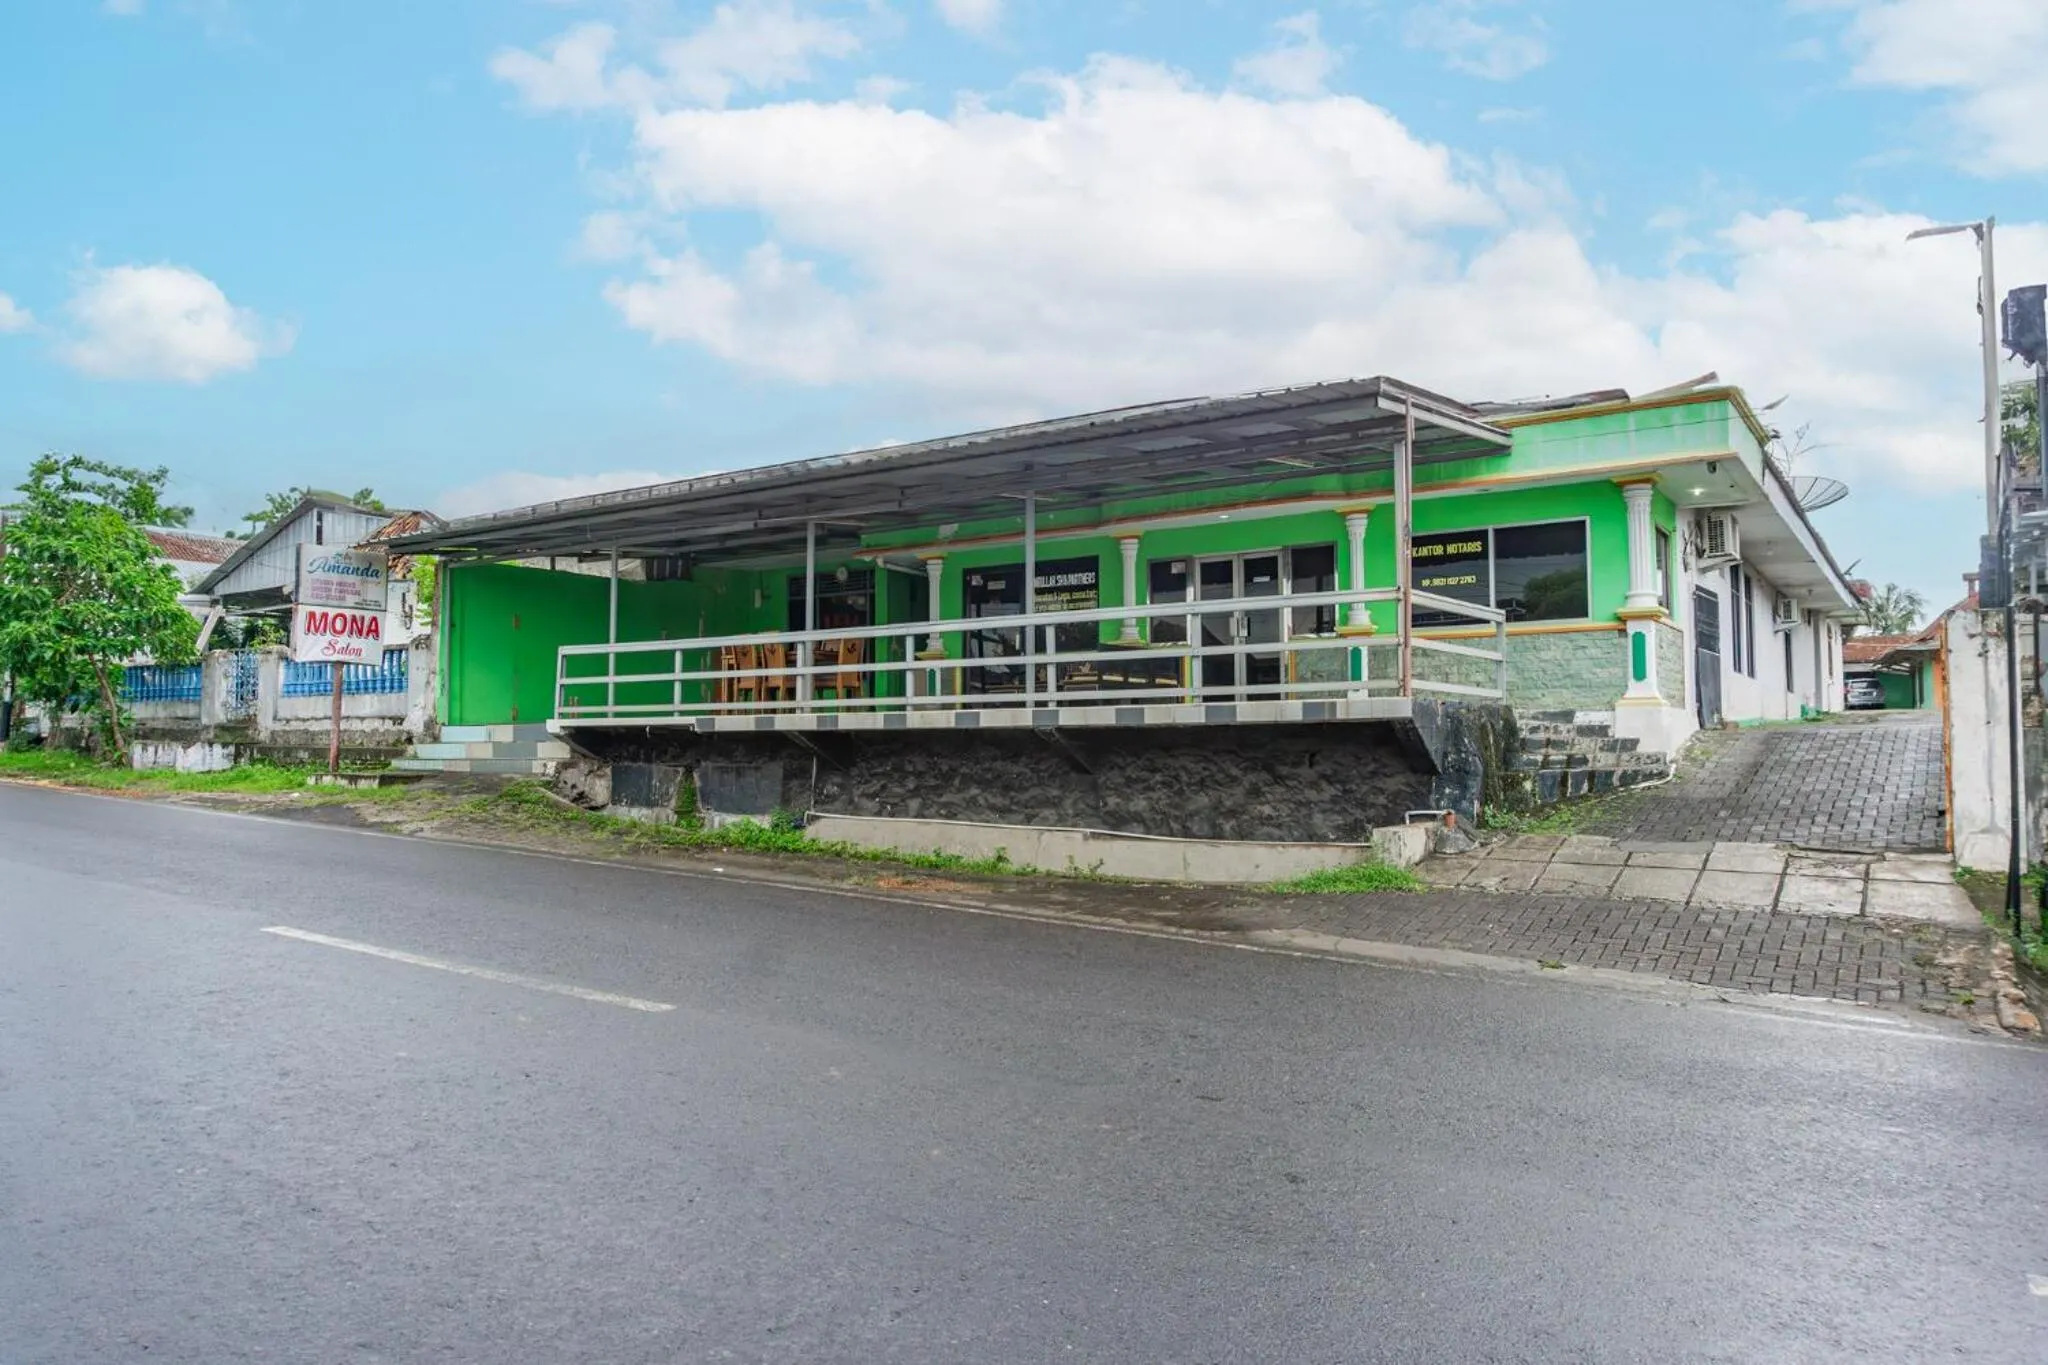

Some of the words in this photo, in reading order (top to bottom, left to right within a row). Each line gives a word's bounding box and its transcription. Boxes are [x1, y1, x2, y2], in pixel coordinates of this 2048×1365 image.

[1412, 545, 1444, 557] KANTOR
[1447, 541, 1482, 554] NOTARIS
[308, 556, 381, 578] Amanda
[305, 610, 380, 640] MONA
[321, 639, 363, 657] Salon
